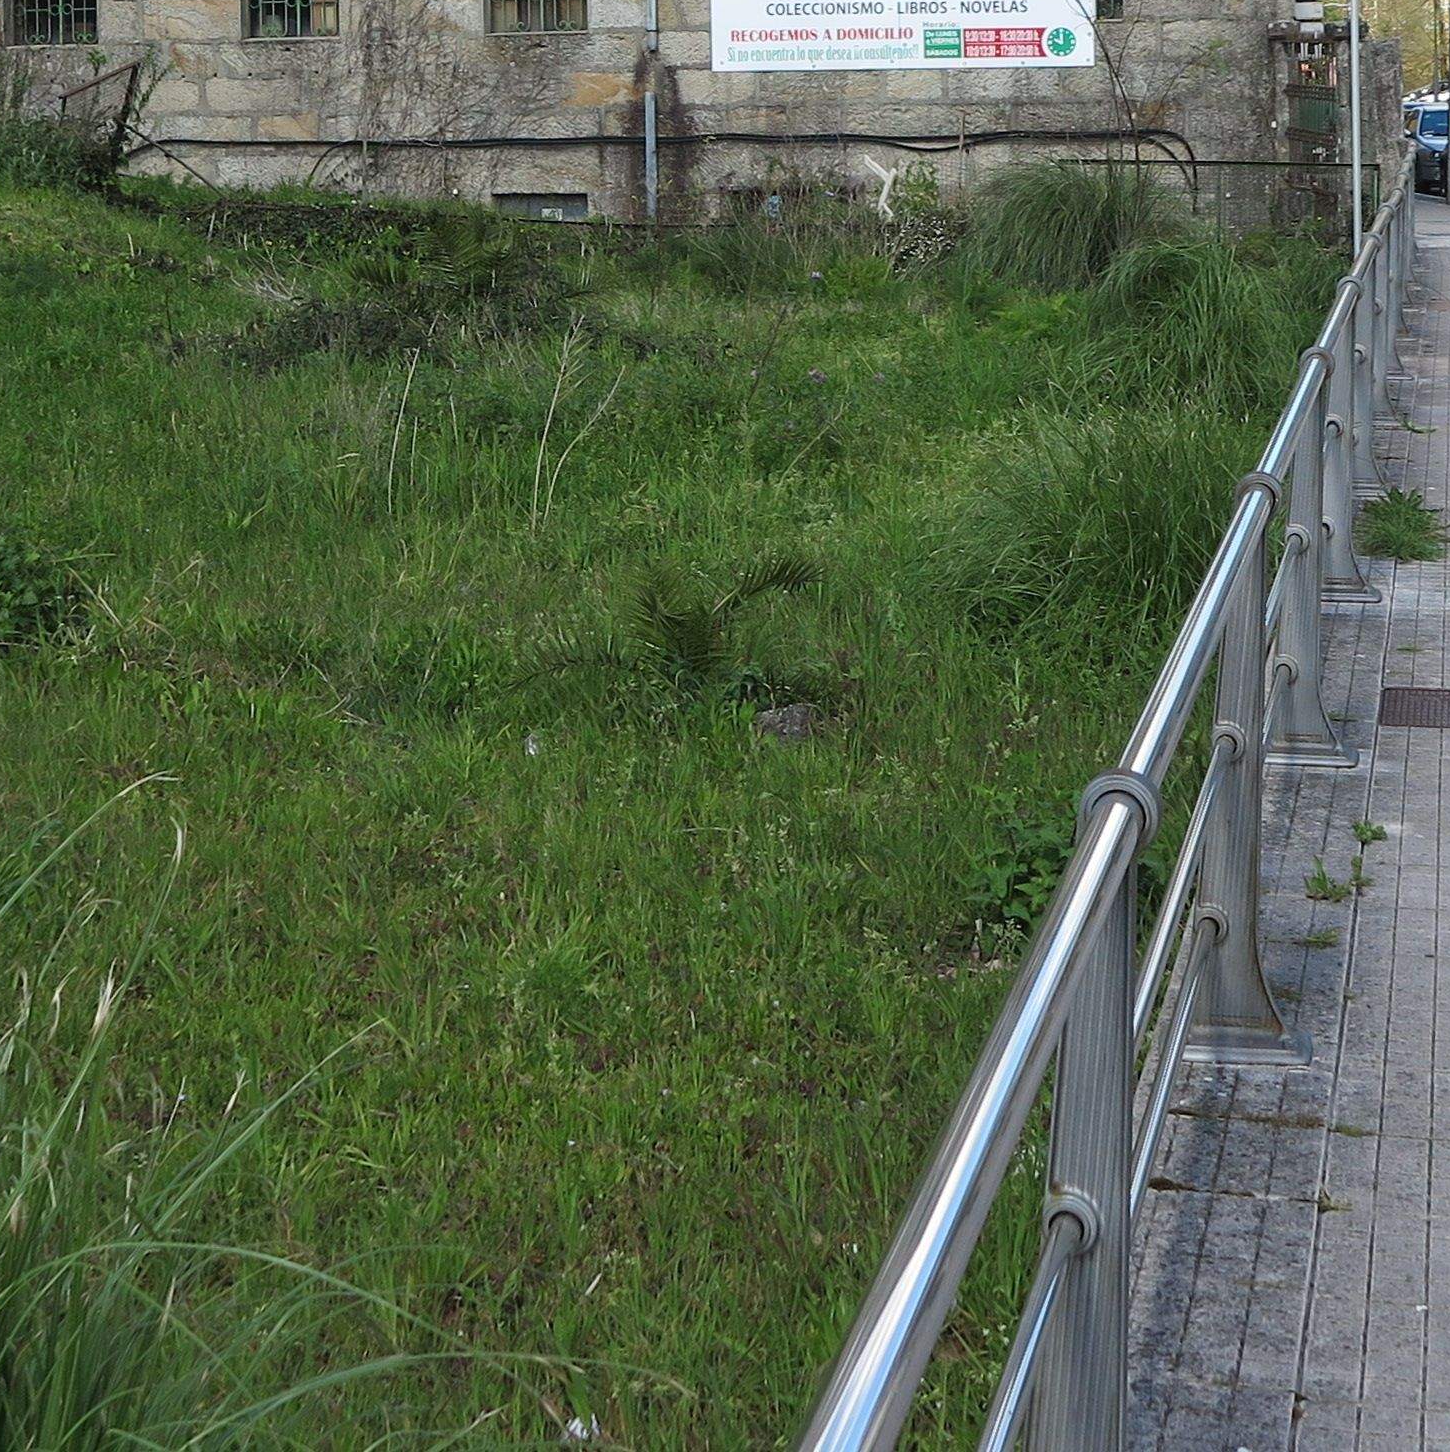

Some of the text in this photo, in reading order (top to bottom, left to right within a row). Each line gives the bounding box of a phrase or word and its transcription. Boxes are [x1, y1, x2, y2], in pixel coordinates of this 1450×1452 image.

[766, 0, 1029, 16] COLECCIONISMO LIBROS NOVELAS
[730, 27, 914, 42] RECOGEMOS A DOMICILIO
[737, 50, 749, 62] no
[750, 48, 795, 62] encuentra
[797, 46, 805, 61] lo
[807, 49, 824, 64] que
[825, 46, 850, 61] desea
